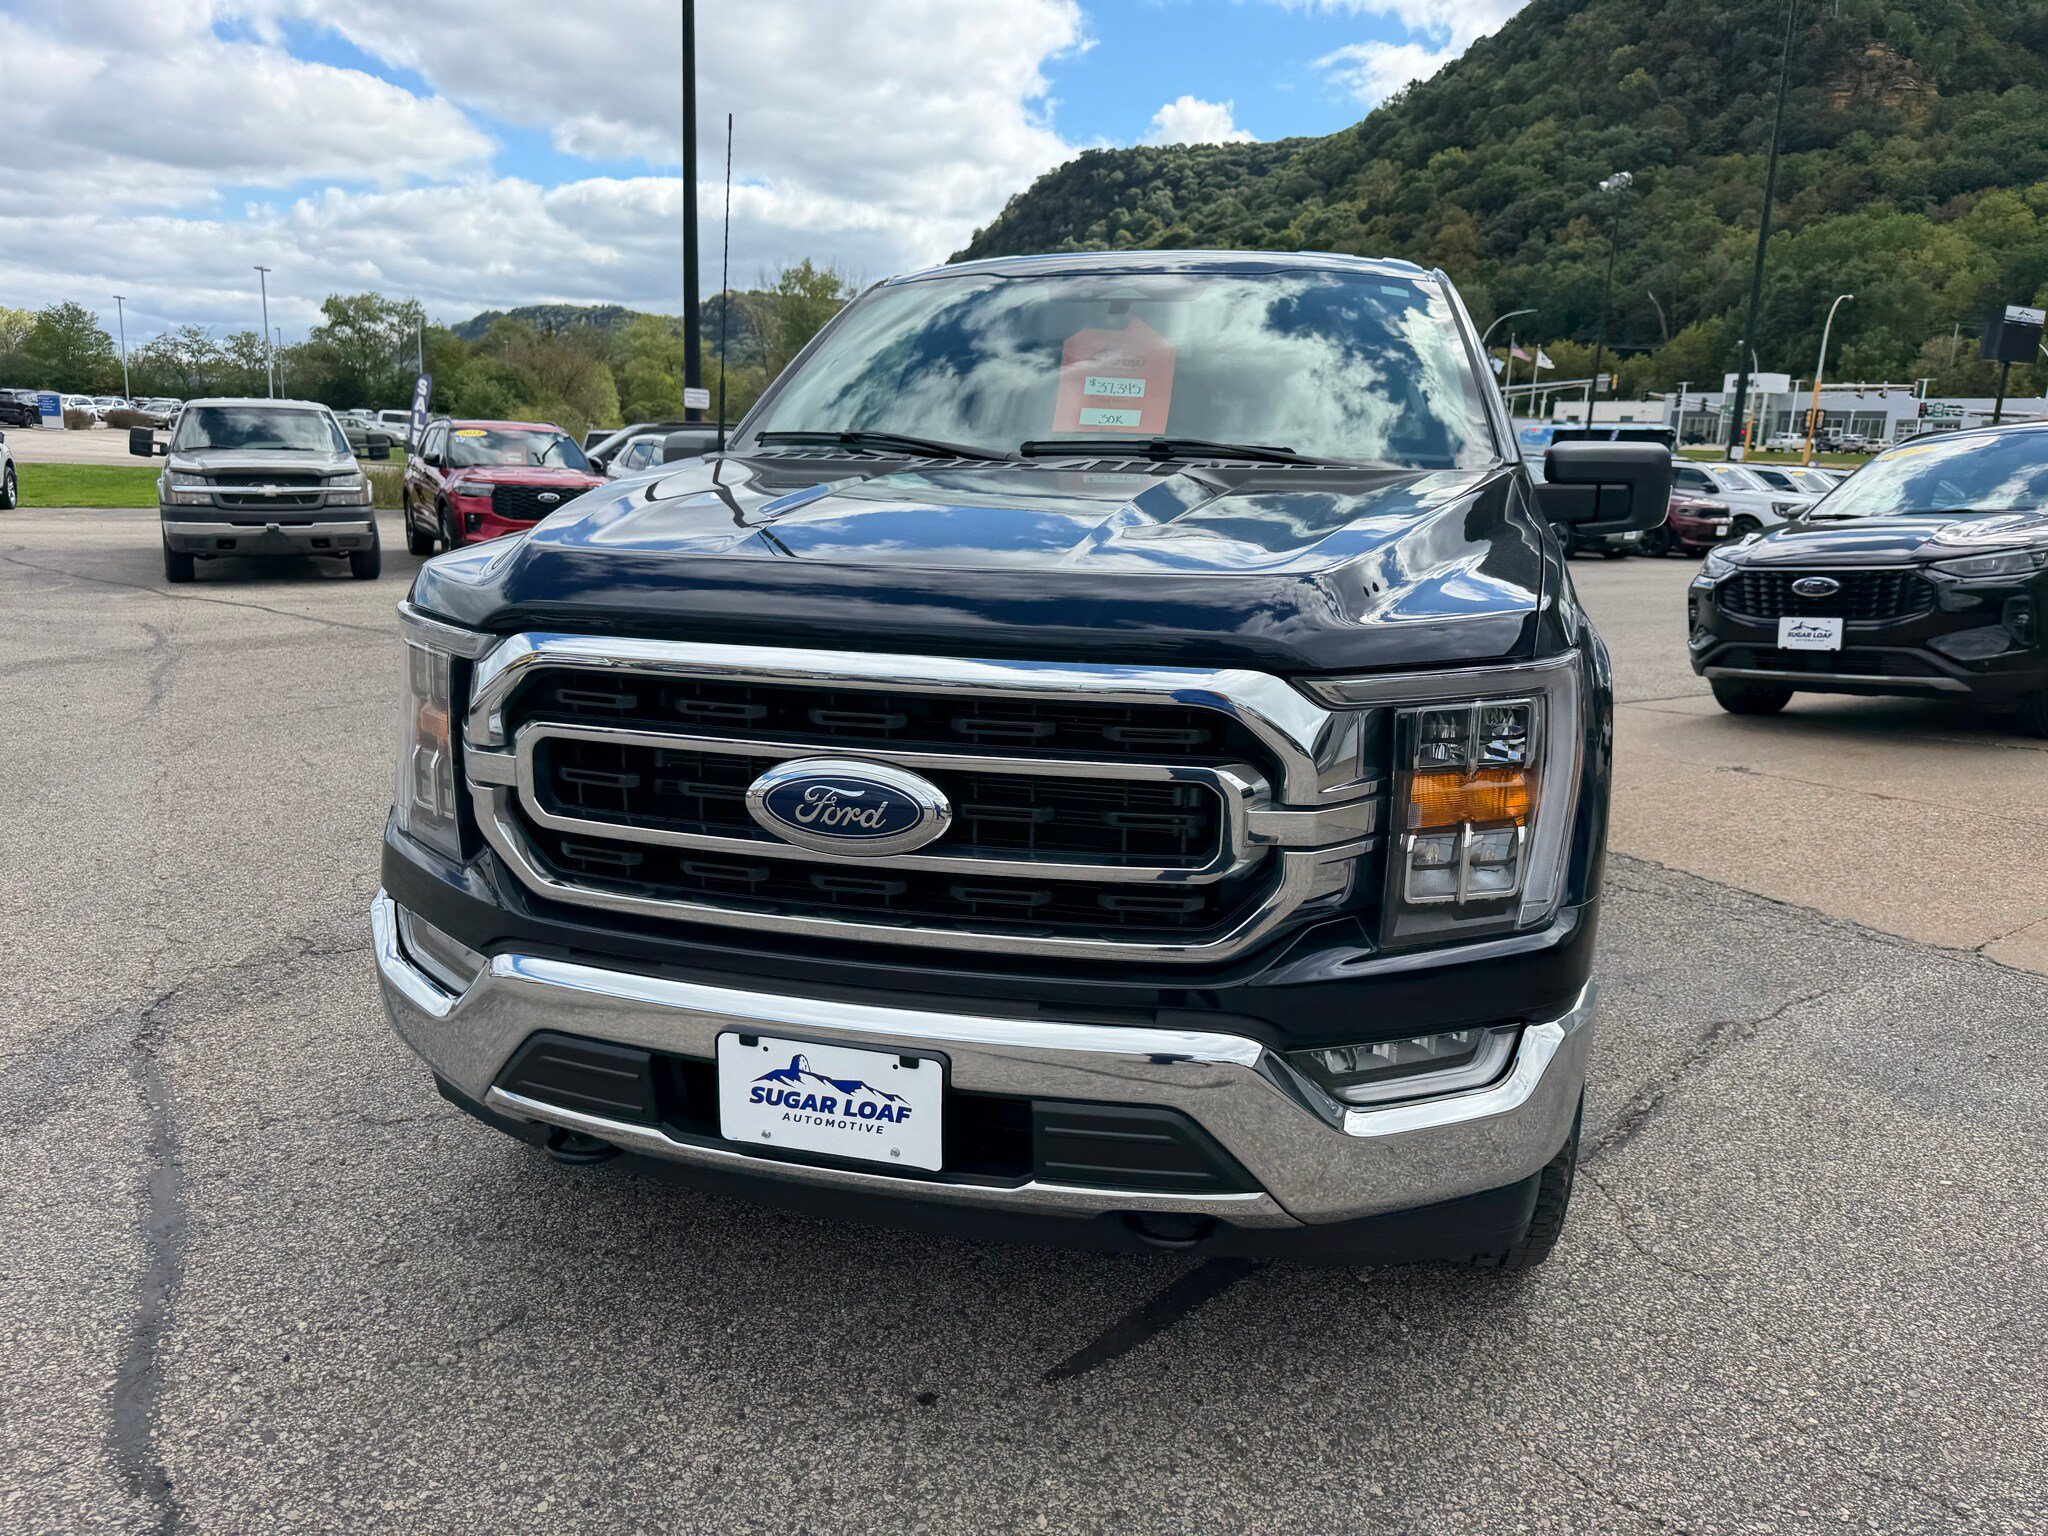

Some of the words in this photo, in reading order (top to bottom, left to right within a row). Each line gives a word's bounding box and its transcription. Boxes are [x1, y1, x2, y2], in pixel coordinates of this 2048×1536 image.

[794, 785, 887, 829] Ford
[749, 1086, 838, 1114] SUGAR
[843, 1098, 913, 1124] LOAF
[781, 1112, 885, 1135] AUTOMOTIVE
